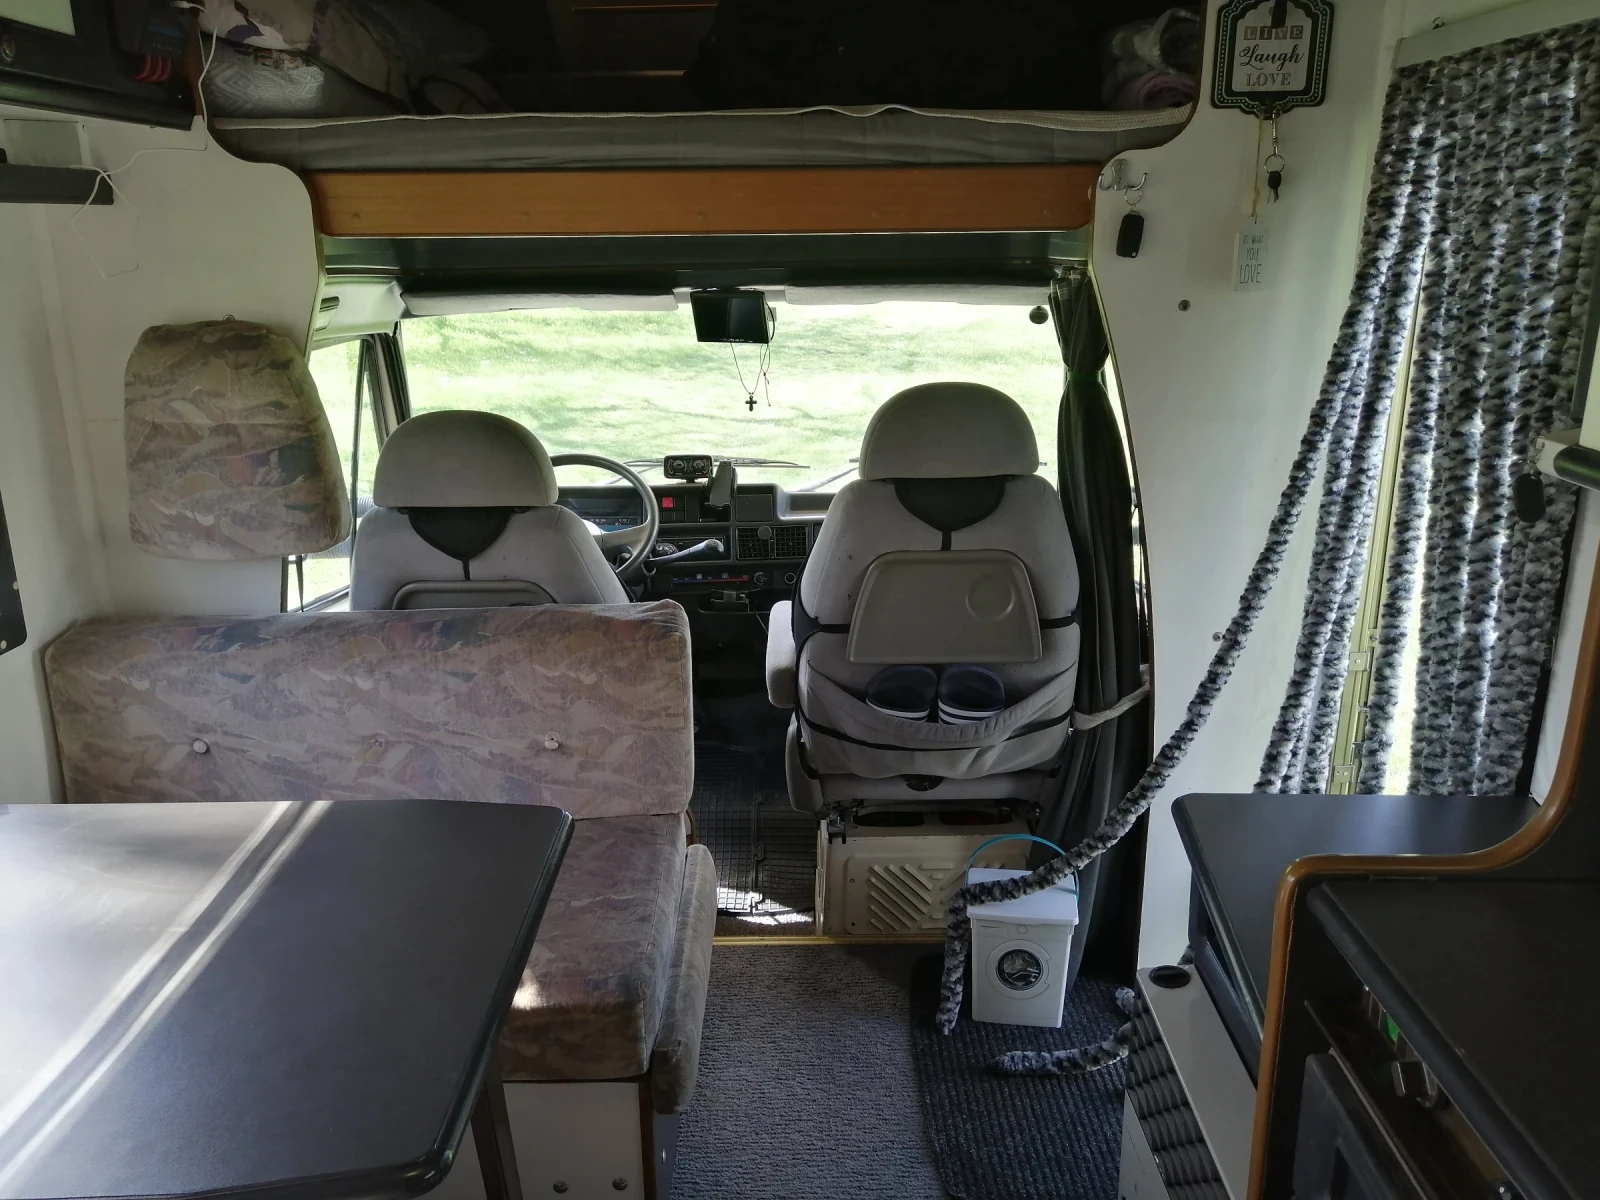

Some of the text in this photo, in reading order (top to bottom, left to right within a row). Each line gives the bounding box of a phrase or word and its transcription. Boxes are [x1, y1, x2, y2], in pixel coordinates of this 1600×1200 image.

[1245, 26, 1303, 40] LIVE
[1239, 44, 1304, 71] Laugh
[1245, 73, 1291, 87] LOVE
[1252, 235, 1264, 244] WHAT
[1246, 248, 1260, 260] YOU
[1239, 264, 1262, 283] LOVE
